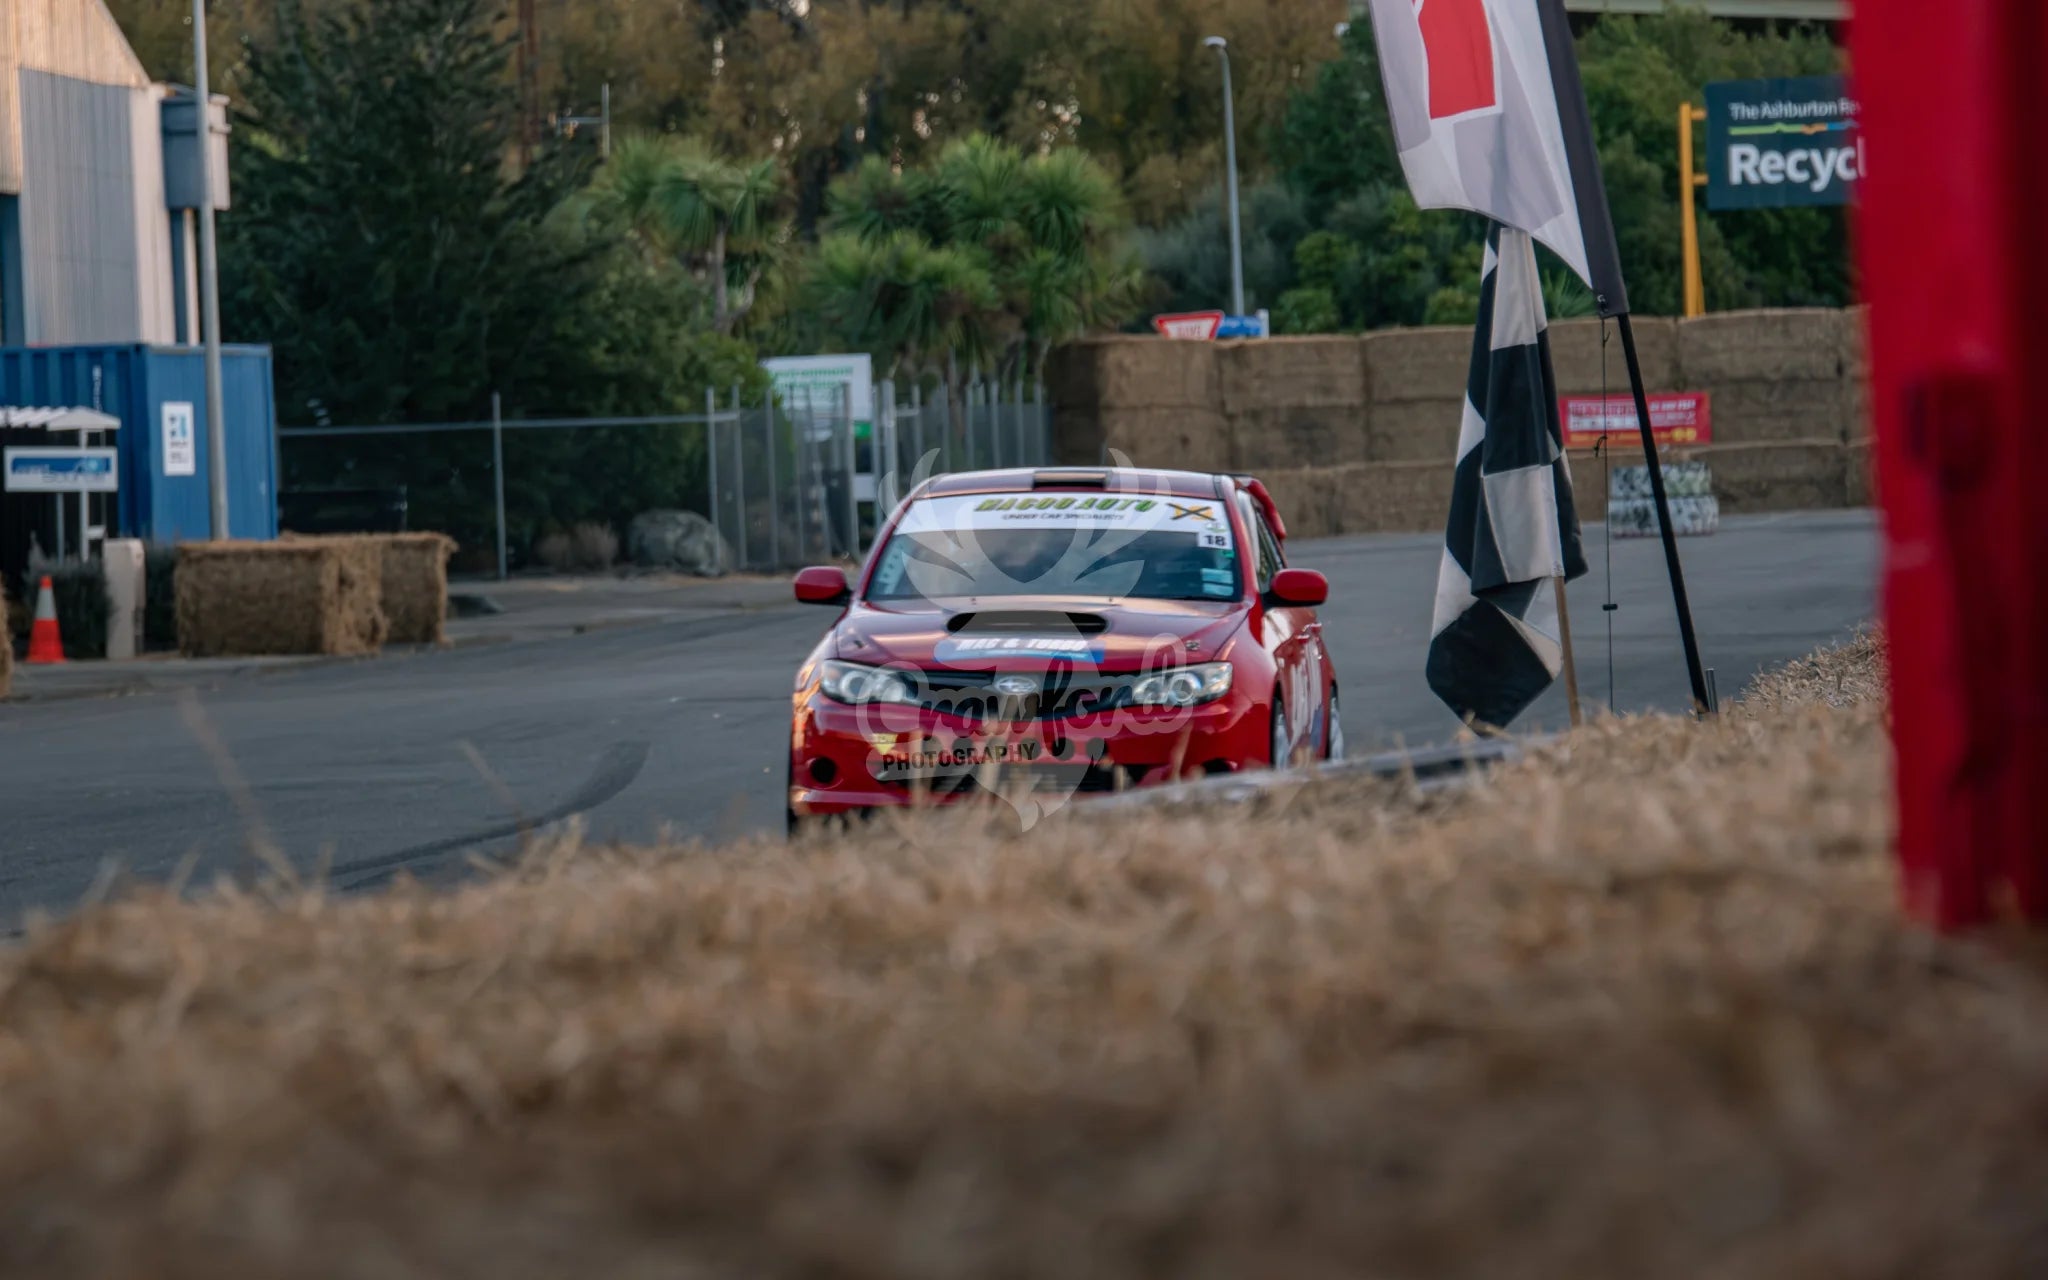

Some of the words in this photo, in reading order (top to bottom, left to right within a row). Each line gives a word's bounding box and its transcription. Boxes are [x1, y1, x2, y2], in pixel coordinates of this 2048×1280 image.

[1729, 102, 1760, 120] The
[1761, 99, 1838, 119] Ashburton
[1728, 136, 1866, 192] Recycl
[1074, 497, 1158, 512] AUTO
[1203, 535, 1227, 547] 18
